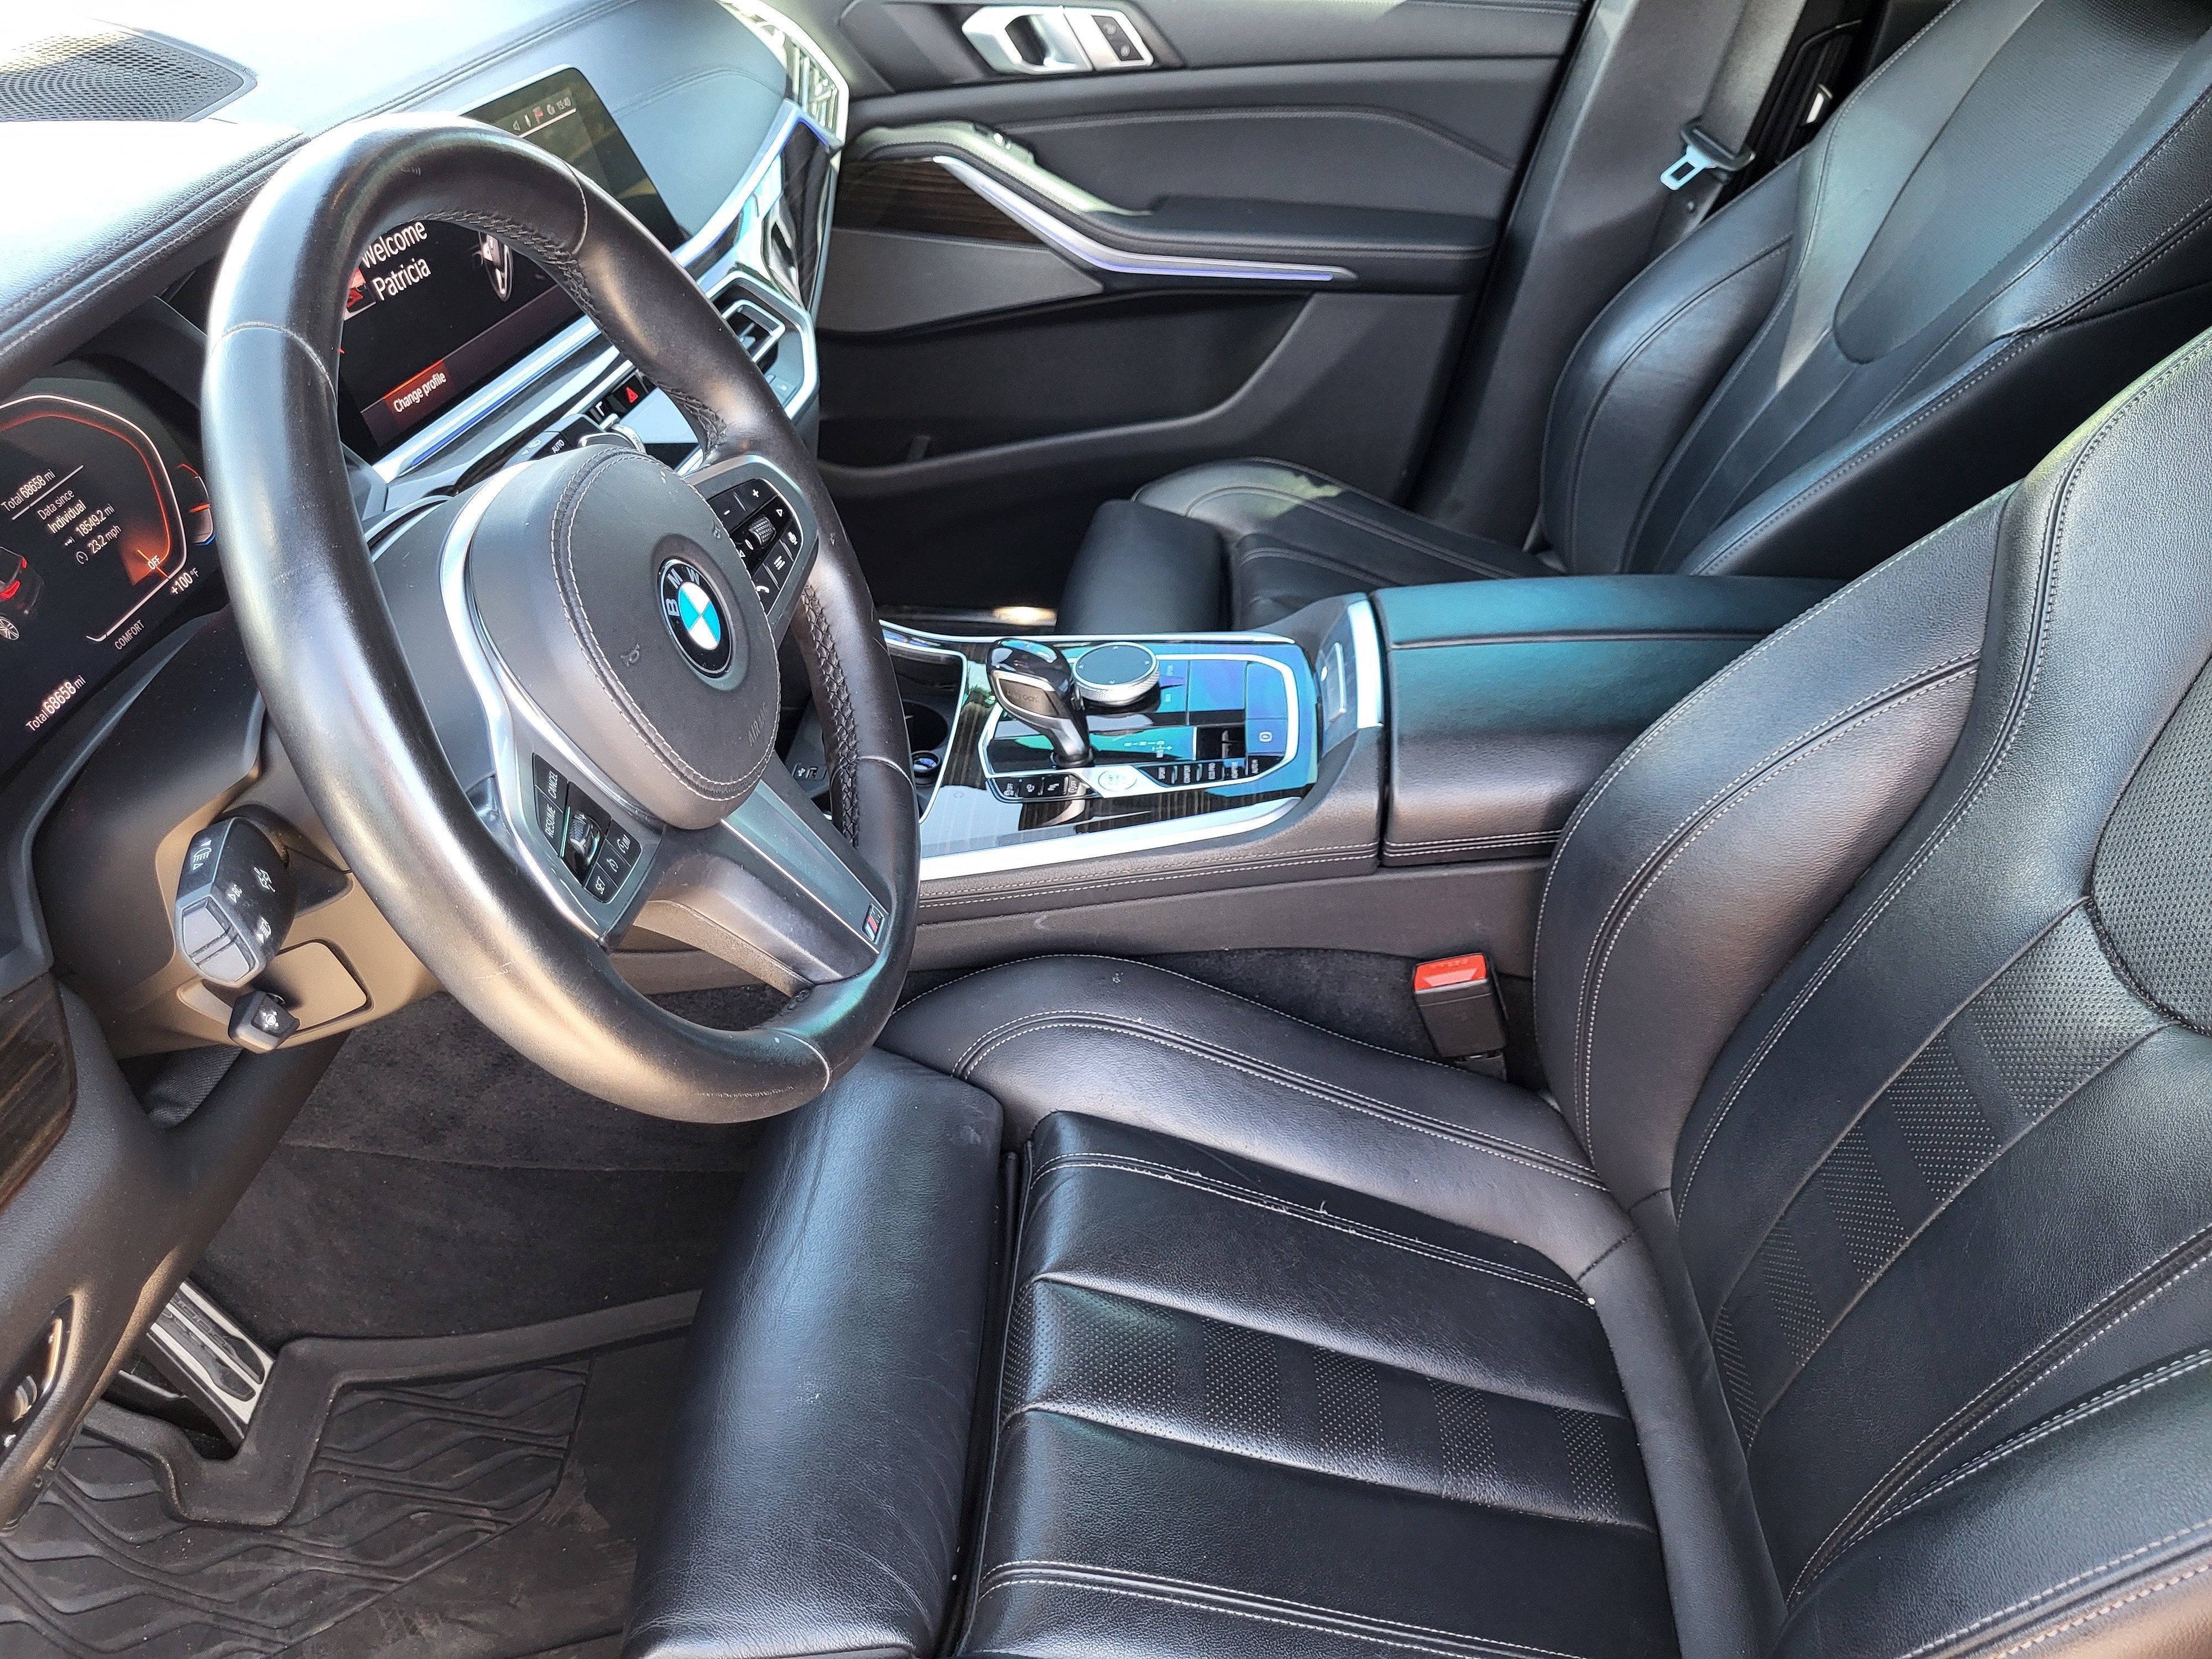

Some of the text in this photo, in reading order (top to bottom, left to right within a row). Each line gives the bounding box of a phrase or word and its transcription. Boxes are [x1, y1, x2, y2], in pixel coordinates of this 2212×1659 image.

[372, 258, 431, 300] Patricia
[394, 373, 446, 413] Change profile
[551, 439, 565, 453] AUTO
[1, 468, 55, 512] Total 68658 mi
[37, 490, 75, 520] Data since
[48, 499, 87, 534] Individual
[75, 503, 115, 537] 18549.2 mi
[88, 525, 122, 554] 23.2 mph
[148, 555, 161, 570] OFF
[666, 566, 700, 617] BMW
[114, 619, 145, 650] COMFORT
[25, 675, 86, 731] Total 68658 mi
[547, 770, 558, 799] CANCEL
[545, 804, 556, 838] RESUME
[595, 876, 606, 895] SET
